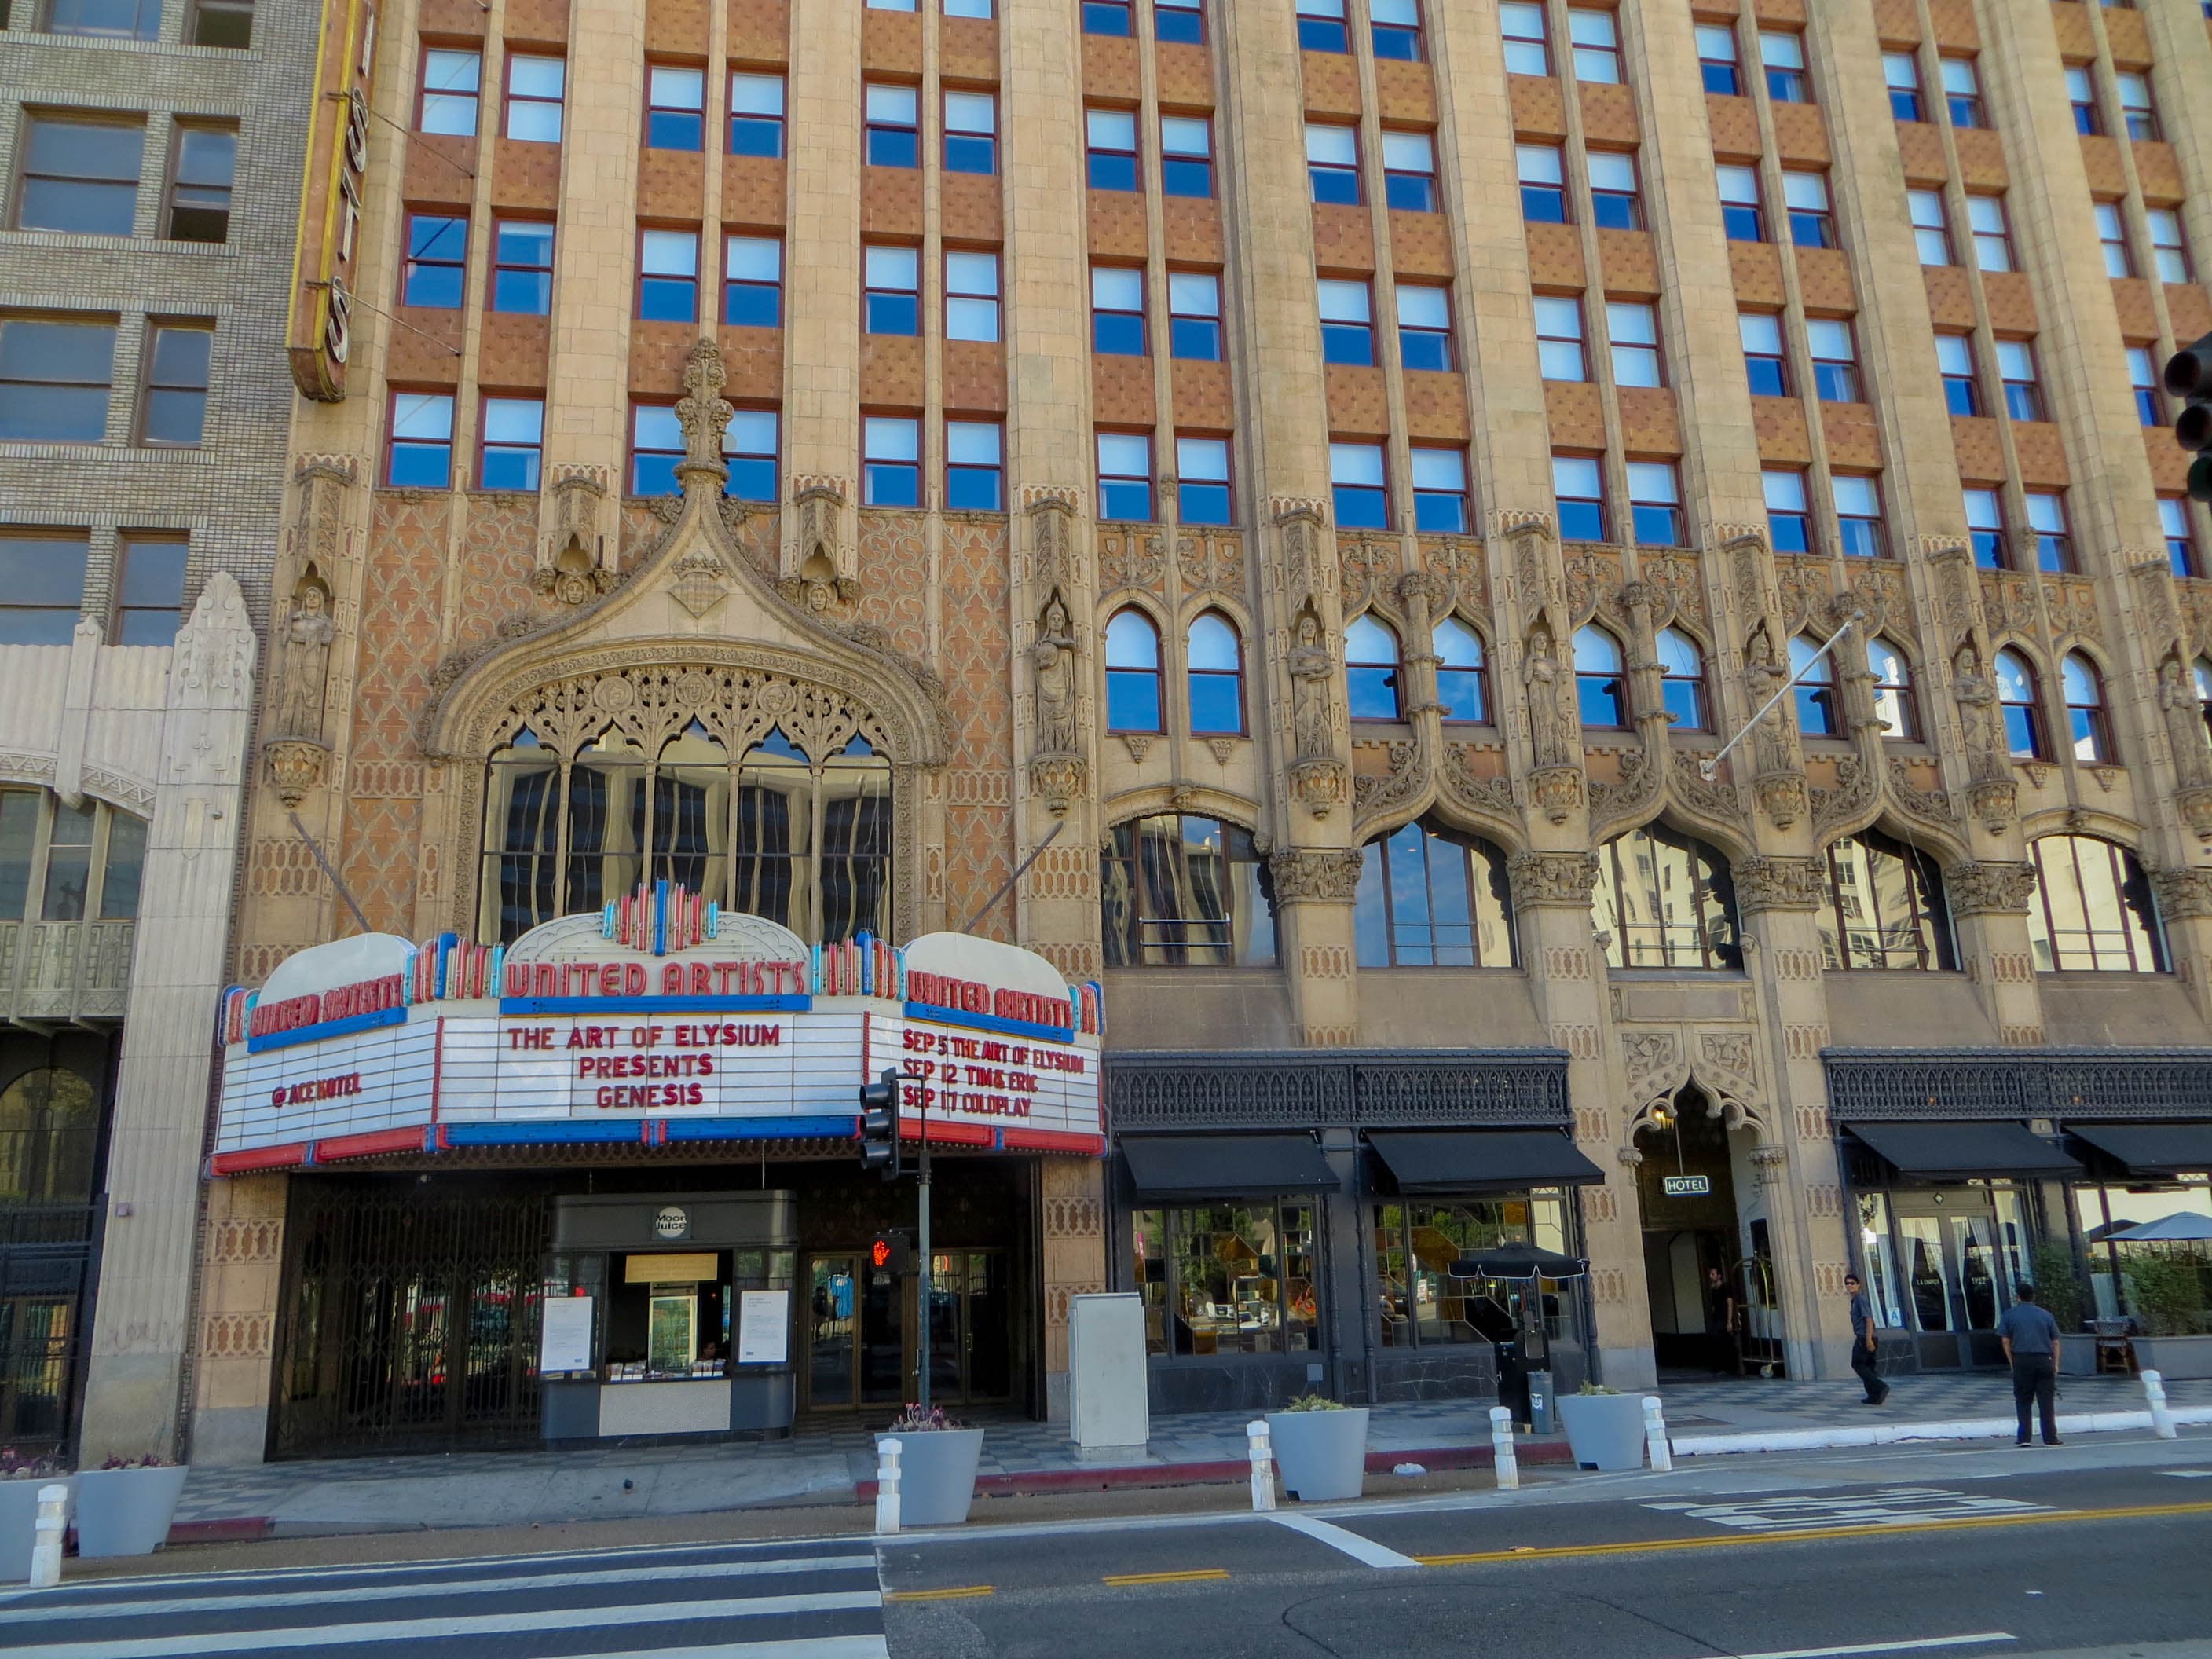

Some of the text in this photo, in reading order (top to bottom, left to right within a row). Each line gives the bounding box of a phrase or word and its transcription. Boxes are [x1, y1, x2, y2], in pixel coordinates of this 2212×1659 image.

[505, 961, 805, 998] UNITED ARTISTS
[908, 970, 991, 1014] UNITED
[250, 994, 320, 1038] UNITED
[507, 1024, 779, 1050] THE ART OF ELYSIUM
[903, 1029, 1084, 1074] SEP 5 THE ART OF ELYSIUM
[579, 1053, 713, 1079] PRESENTS
[903, 1058, 935, 1080] SEP
[942, 1063, 958, 1084] 12
[1009, 1071, 1038, 1092] ERIC
[288, 1080, 314, 1105] ACE
[317, 1072, 362, 1101] HOTEL
[597, 1082, 704, 1108] GENESIS
[903, 1085, 1031, 1117] SEP 17 COLDPLAY
[1668, 1180, 1705, 1191] HOTEL
[1891, 1310, 1899, 1320] A
